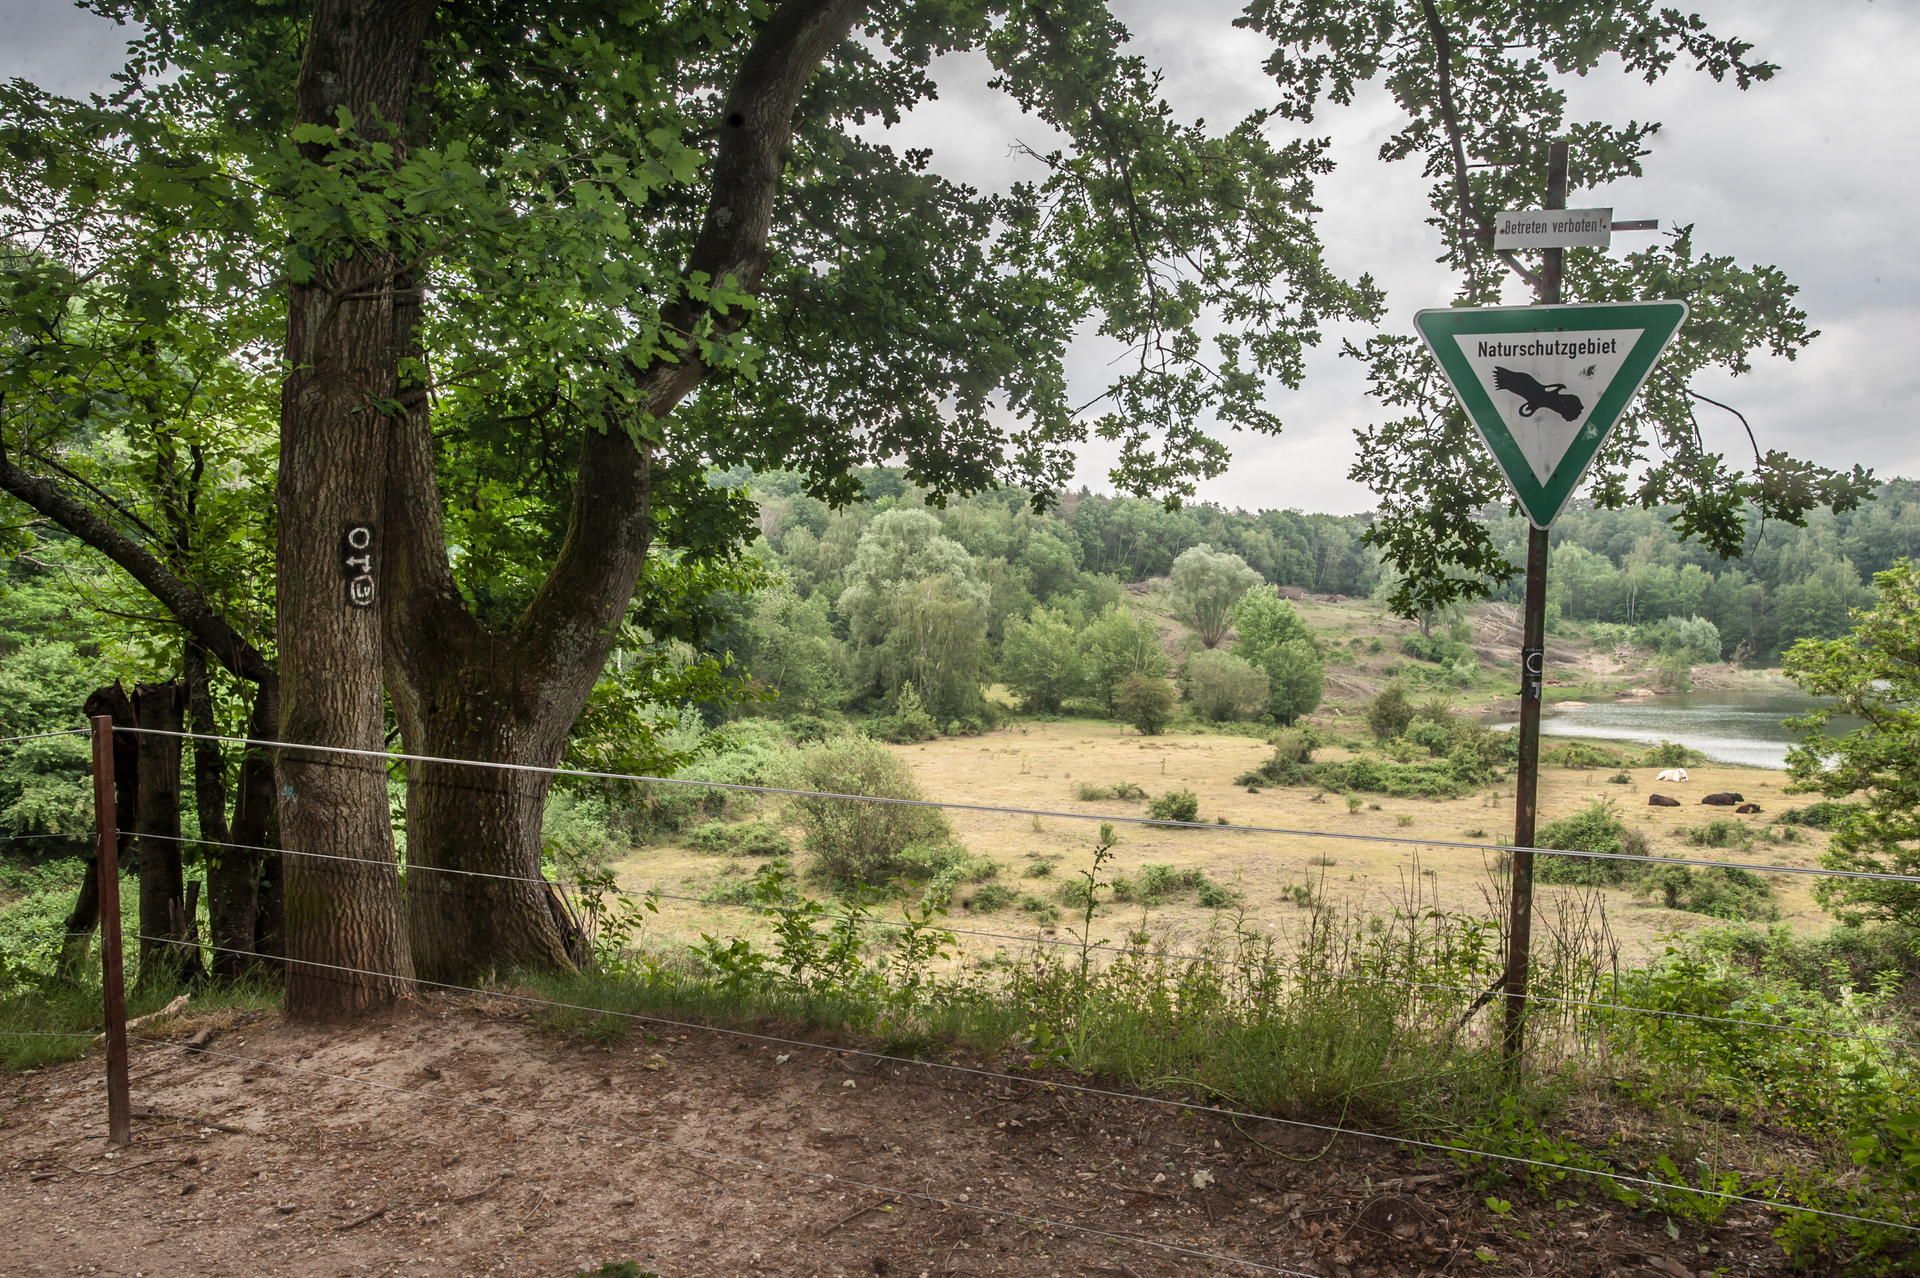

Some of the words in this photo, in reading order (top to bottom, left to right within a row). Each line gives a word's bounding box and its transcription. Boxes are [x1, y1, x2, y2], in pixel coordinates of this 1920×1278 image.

[1505, 220, 1548, 235] Betreten
[1552, 218, 1602, 233] verboten!
[1478, 338, 1616, 359] Naturschutzgebiet
